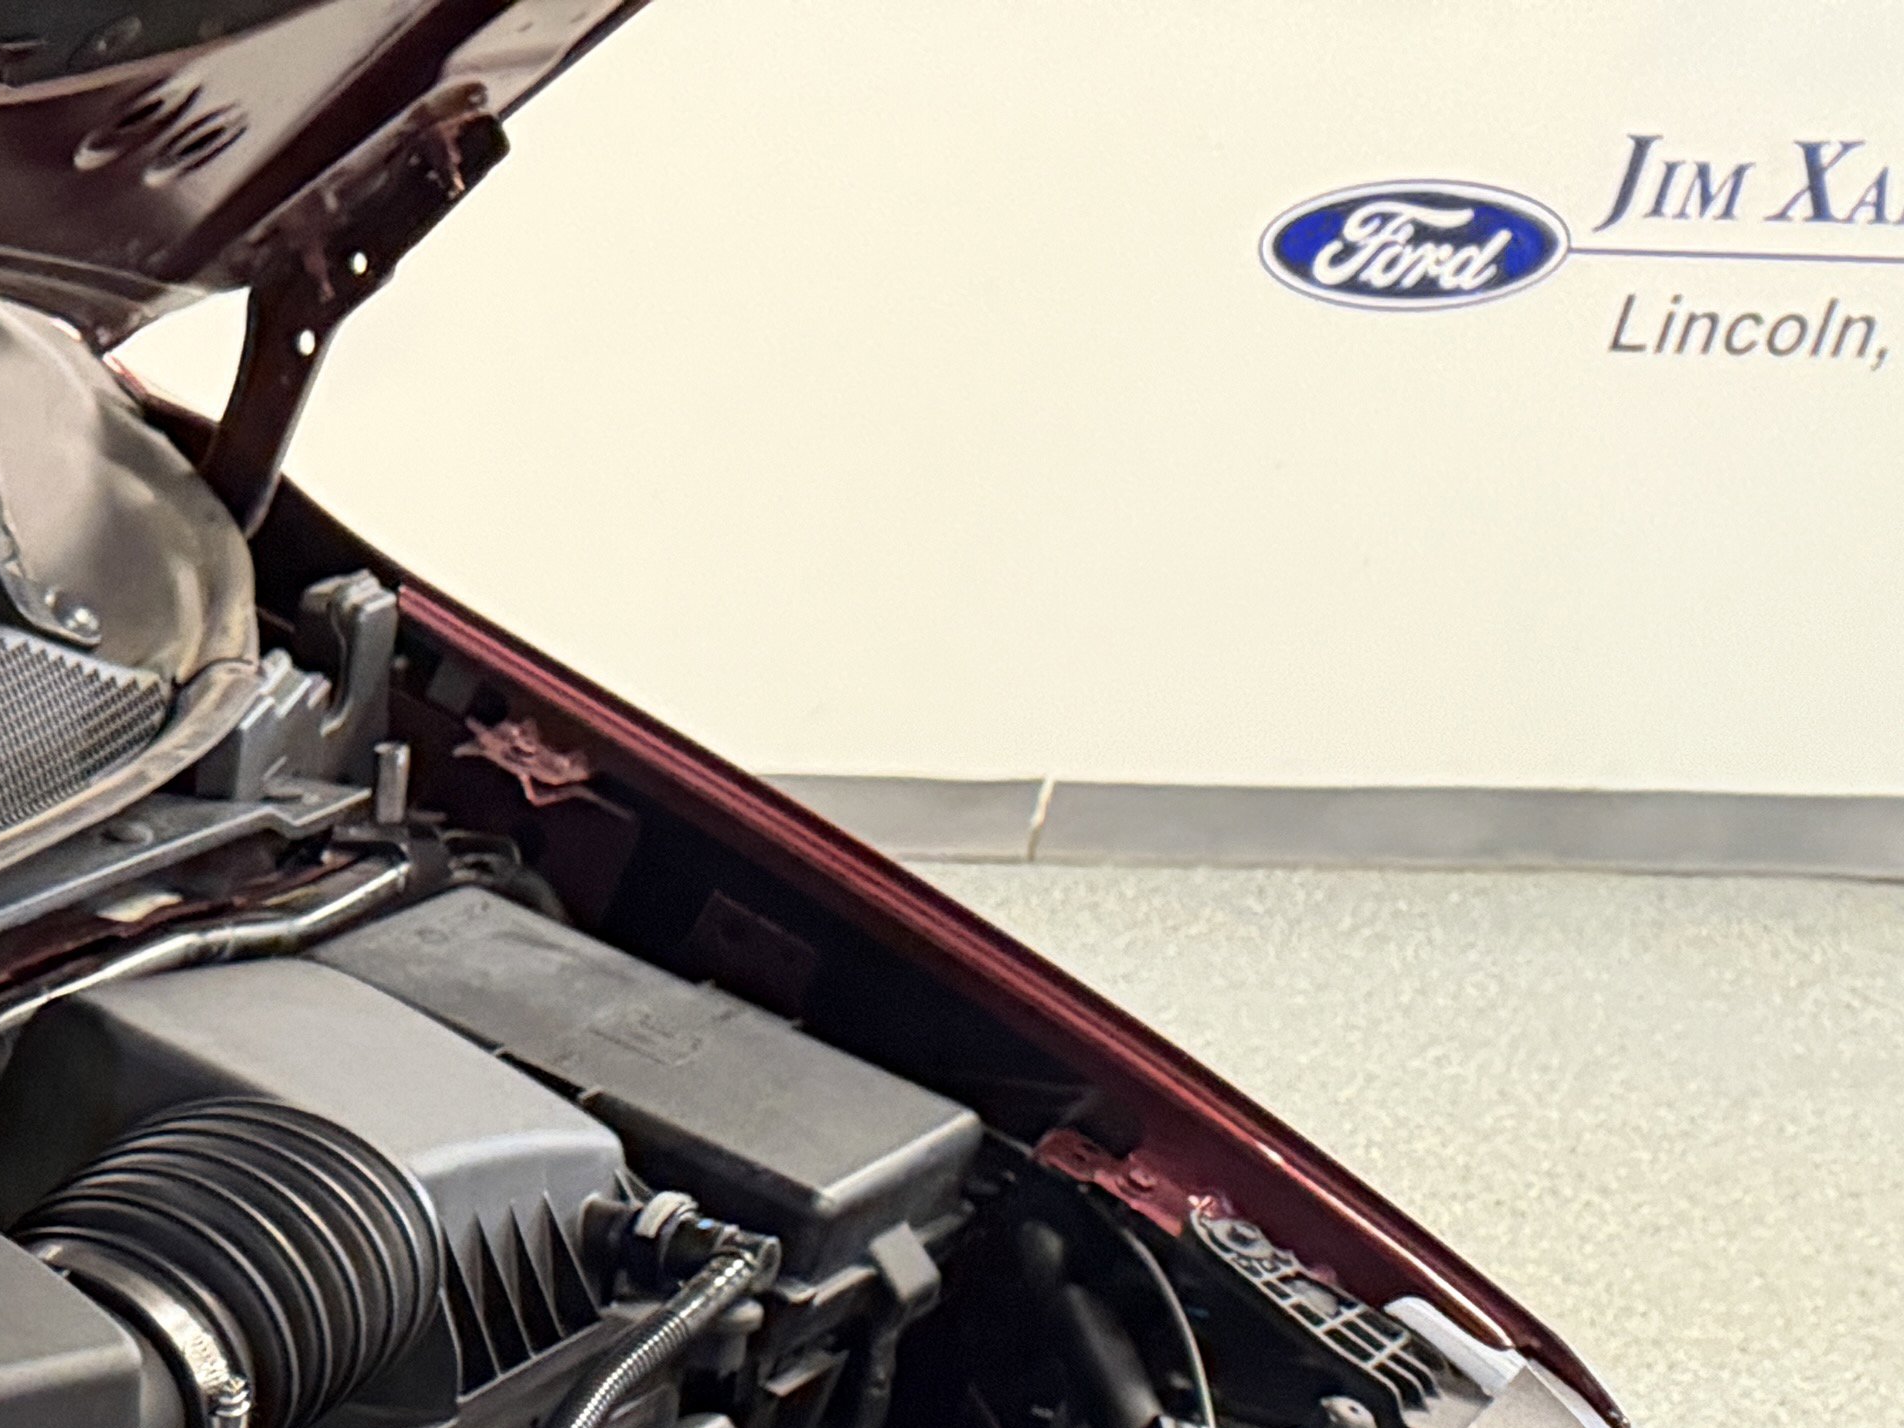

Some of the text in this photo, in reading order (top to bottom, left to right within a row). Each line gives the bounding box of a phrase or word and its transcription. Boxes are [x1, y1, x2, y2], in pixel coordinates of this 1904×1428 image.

[1591, 134, 1904, 233] JIM XA
[1311, 200, 1512, 290] Ford
[1608, 294, 1890, 372] Lincoln,
